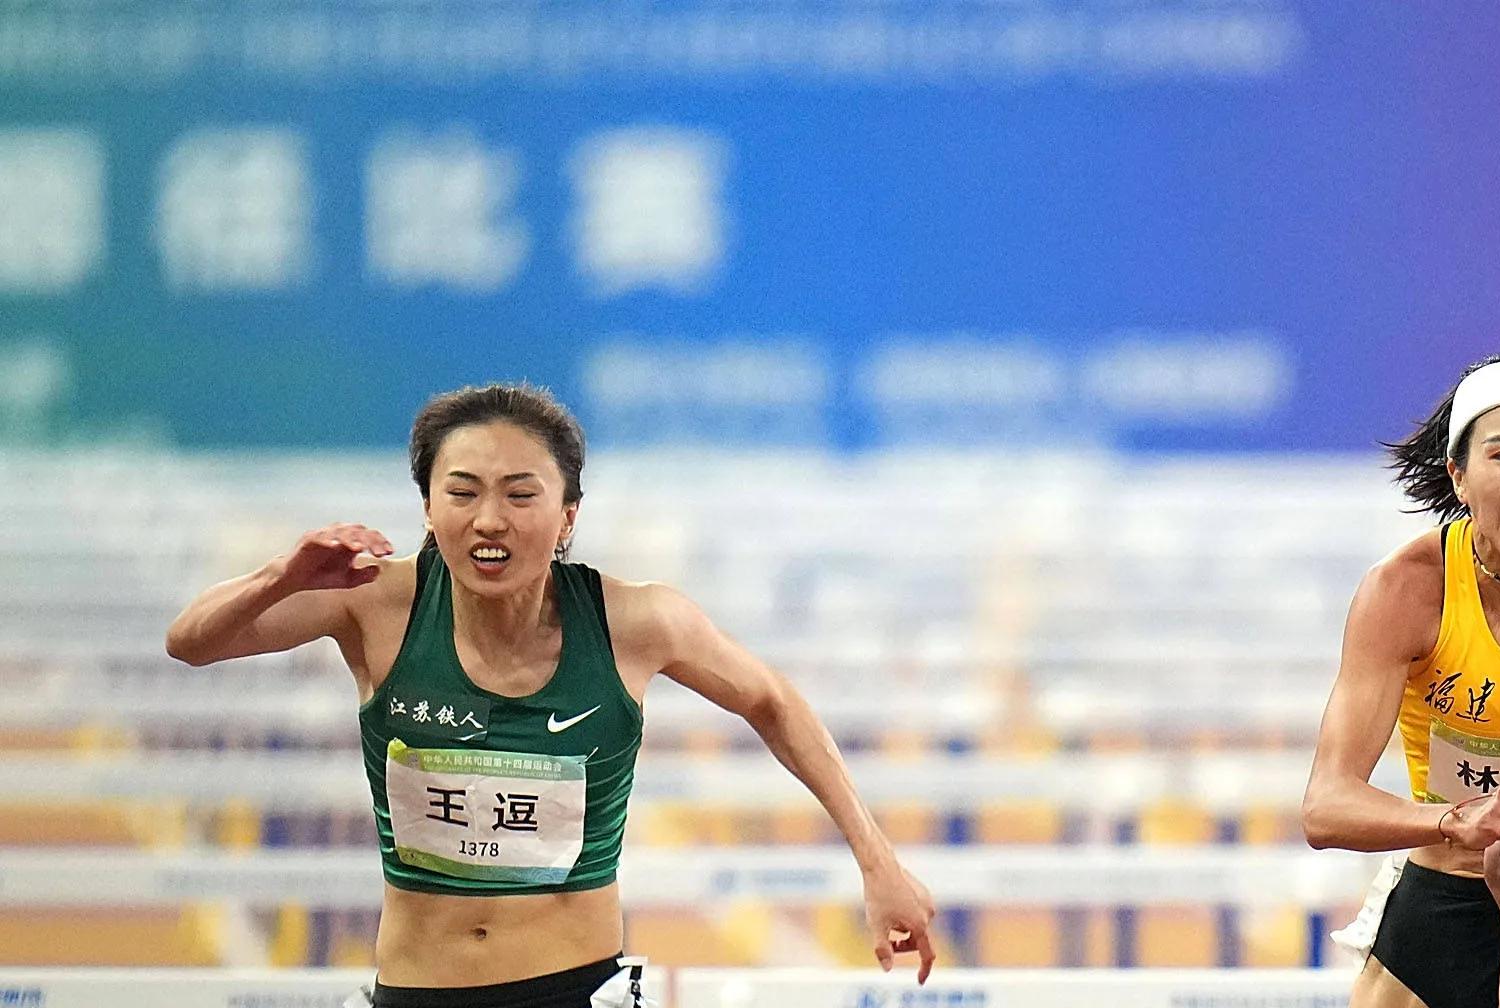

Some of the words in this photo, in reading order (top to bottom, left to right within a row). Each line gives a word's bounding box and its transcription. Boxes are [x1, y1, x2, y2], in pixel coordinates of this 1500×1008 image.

[389, 697, 484, 729] 江苏铁人
[425, 786, 539, 832] 王逗
[458, 840, 500, 857] 1378
